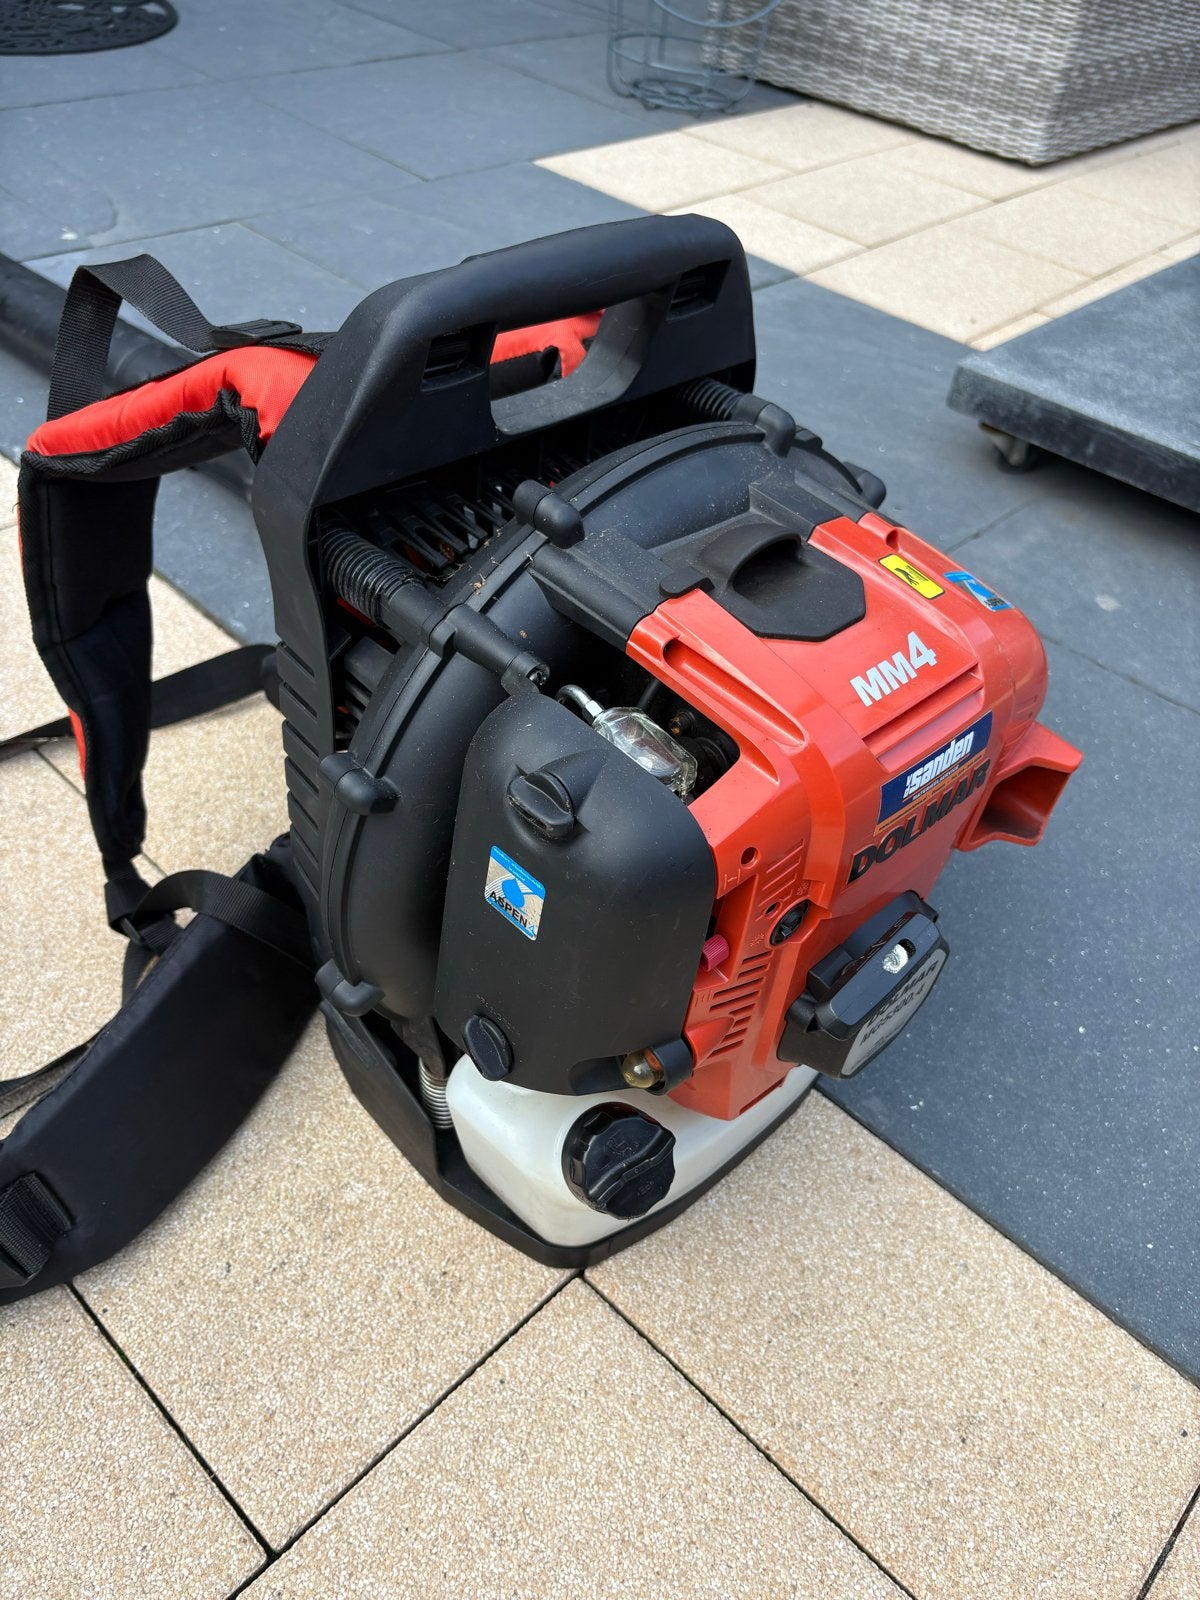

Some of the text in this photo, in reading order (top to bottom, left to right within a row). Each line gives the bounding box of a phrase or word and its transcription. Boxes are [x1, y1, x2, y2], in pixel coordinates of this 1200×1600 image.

[849, 631, 938, 707] MM4
[847, 758, 991, 885] DOLMAR
[488, 890, 528, 928] ASPEN
